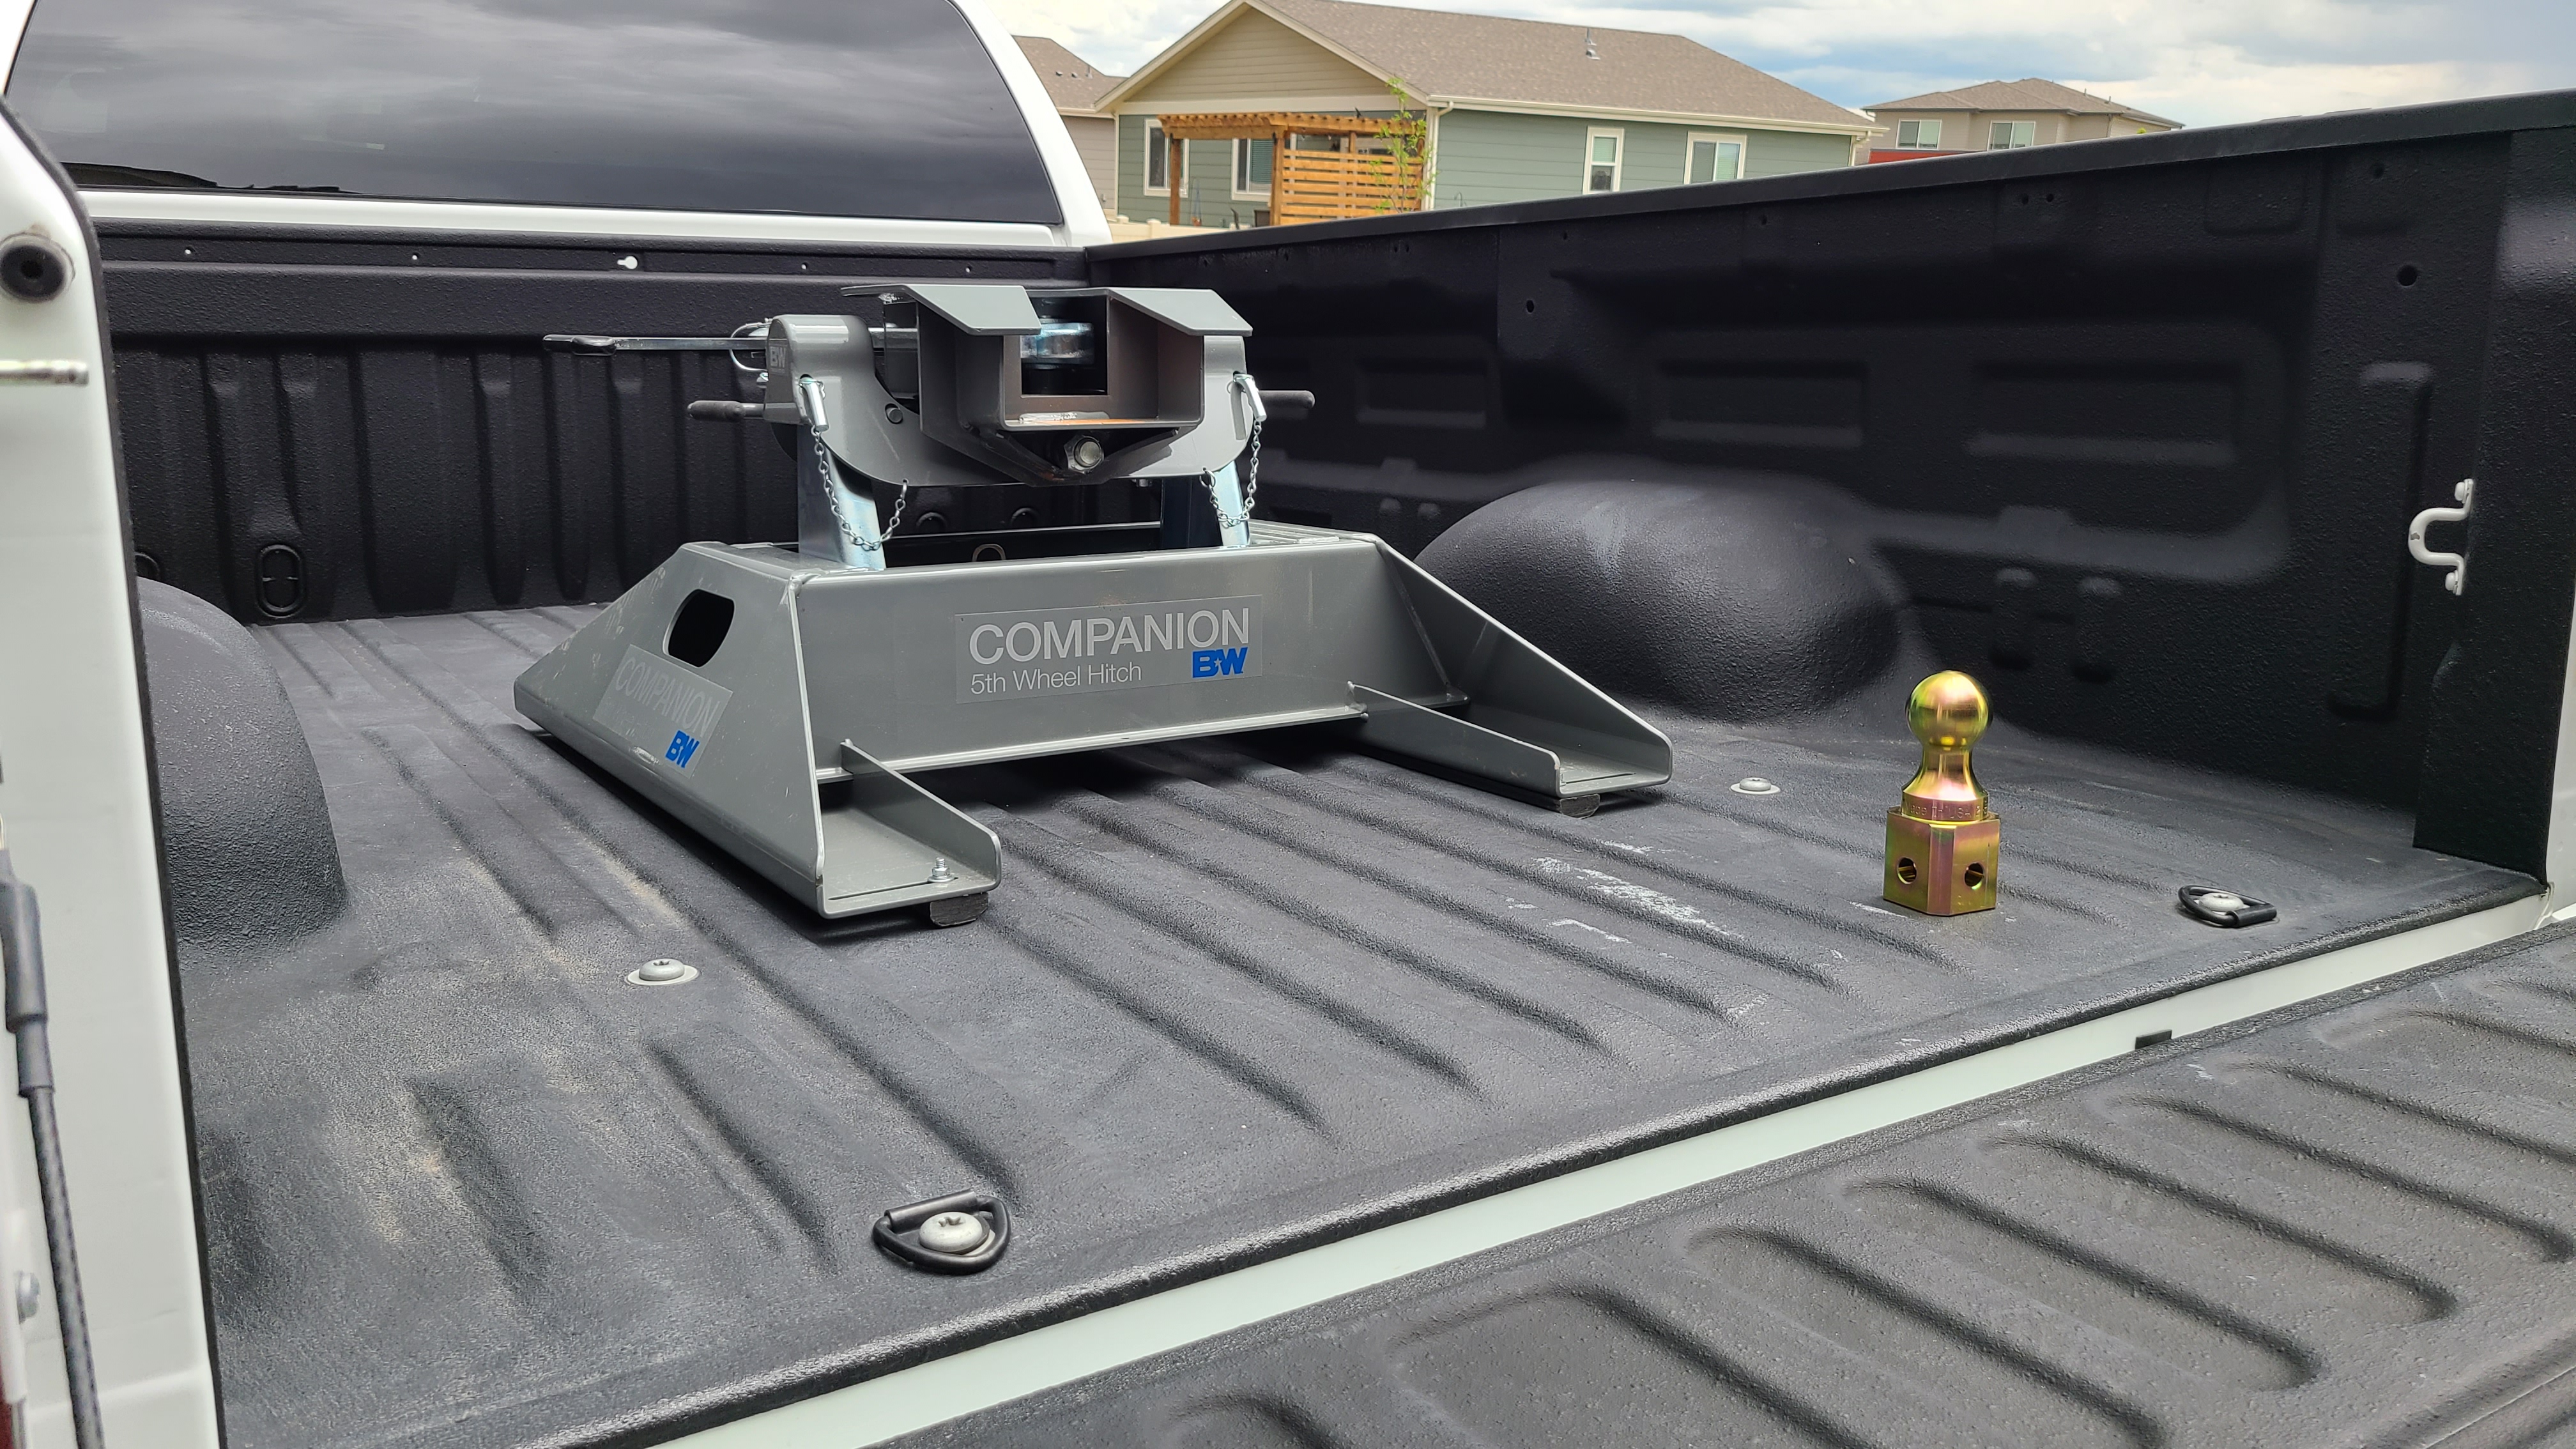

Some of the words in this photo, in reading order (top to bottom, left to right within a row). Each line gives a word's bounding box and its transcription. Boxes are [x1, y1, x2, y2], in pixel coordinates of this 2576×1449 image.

[969, 607, 1250, 665] COMPANION
[615, 656, 721, 738] COMPANION
[970, 673, 1006, 694] 5th
[1013, 666, 1080, 692] Wheel
[1087, 662, 1142, 686] Hitch
